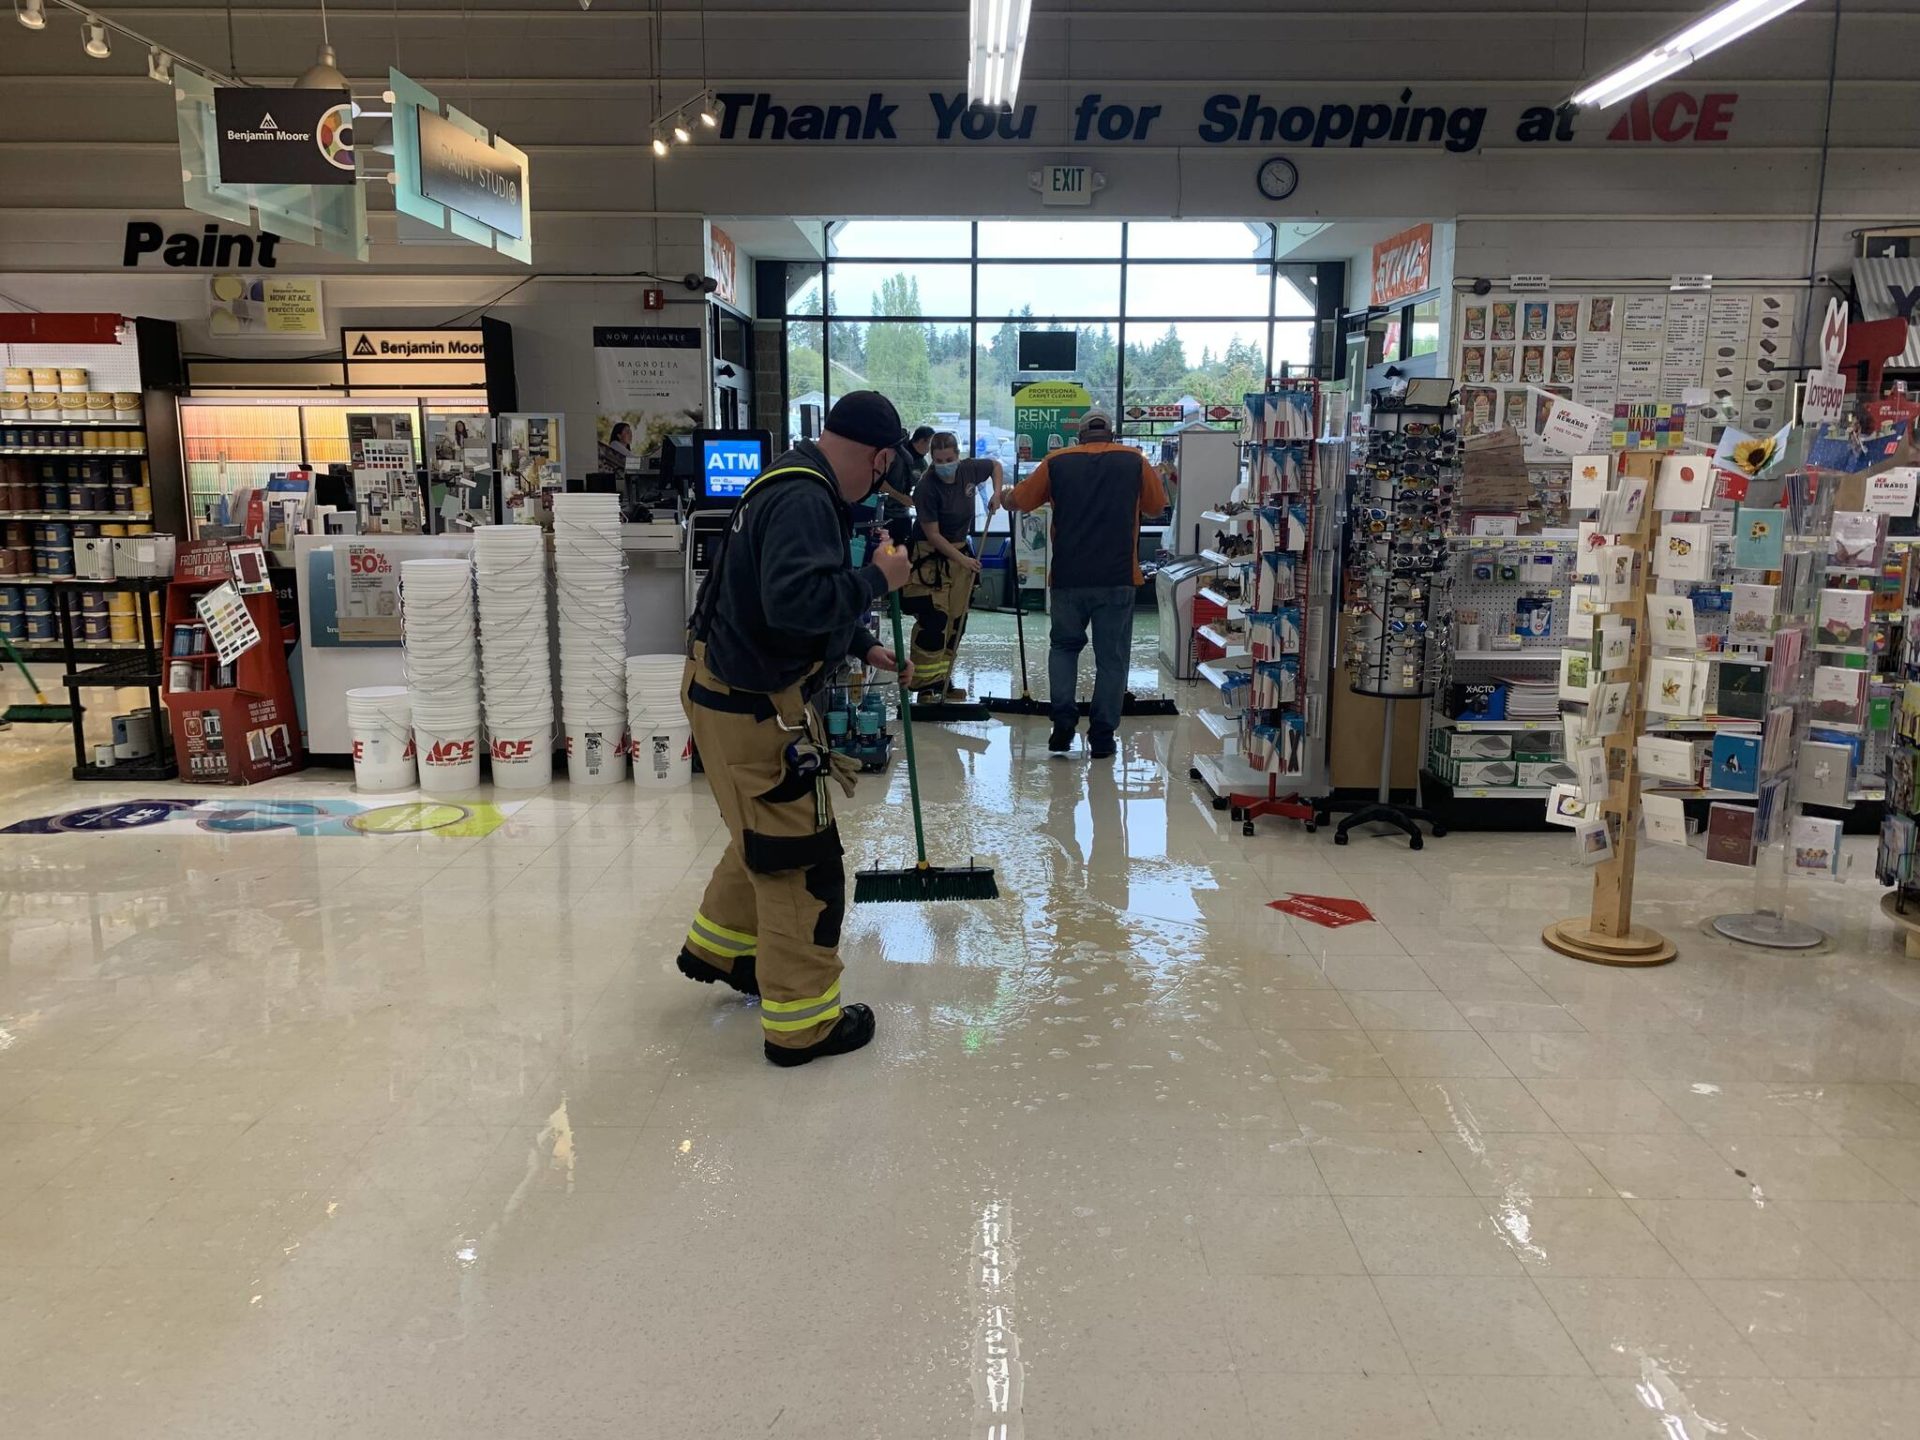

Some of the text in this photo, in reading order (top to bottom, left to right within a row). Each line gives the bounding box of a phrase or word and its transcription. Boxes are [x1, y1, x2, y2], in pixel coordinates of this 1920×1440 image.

[715, 88, 1738, 153] Thank You for Shopping at ACE
[227, 130, 309, 142] Benjamin Moore
[441, 144, 517, 206] PAINT STUDIO
[1052, 167, 1085, 193] EXIT
[124, 222, 280, 268] Paint
[381, 341, 484, 357] Benjamin Moor
[618, 361, 679, 369] MAGNOLIA
[1807, 374, 1842, 416] lovepop
[1018, 408, 1060, 422] RENT
[1630, 404, 1657, 418] HAND
[1017, 421, 1057, 430] RENTAR
[1556, 414, 1589, 430] REWARDS
[1628, 419, 1656, 432] MADE
[707, 453, 759, 470] ATM
[180, 553, 202, 566] FRONT
[203, 552, 223, 564] DOOR
[350, 553, 387, 574] 50%
[378, 565, 392, 573] OFF
[1465, 685, 1496, 694] X-ACTO
[425, 740, 475, 762] ACE
[491, 736, 533, 759] ACE
[1290, 899, 1356, 922] CHECKOUT
